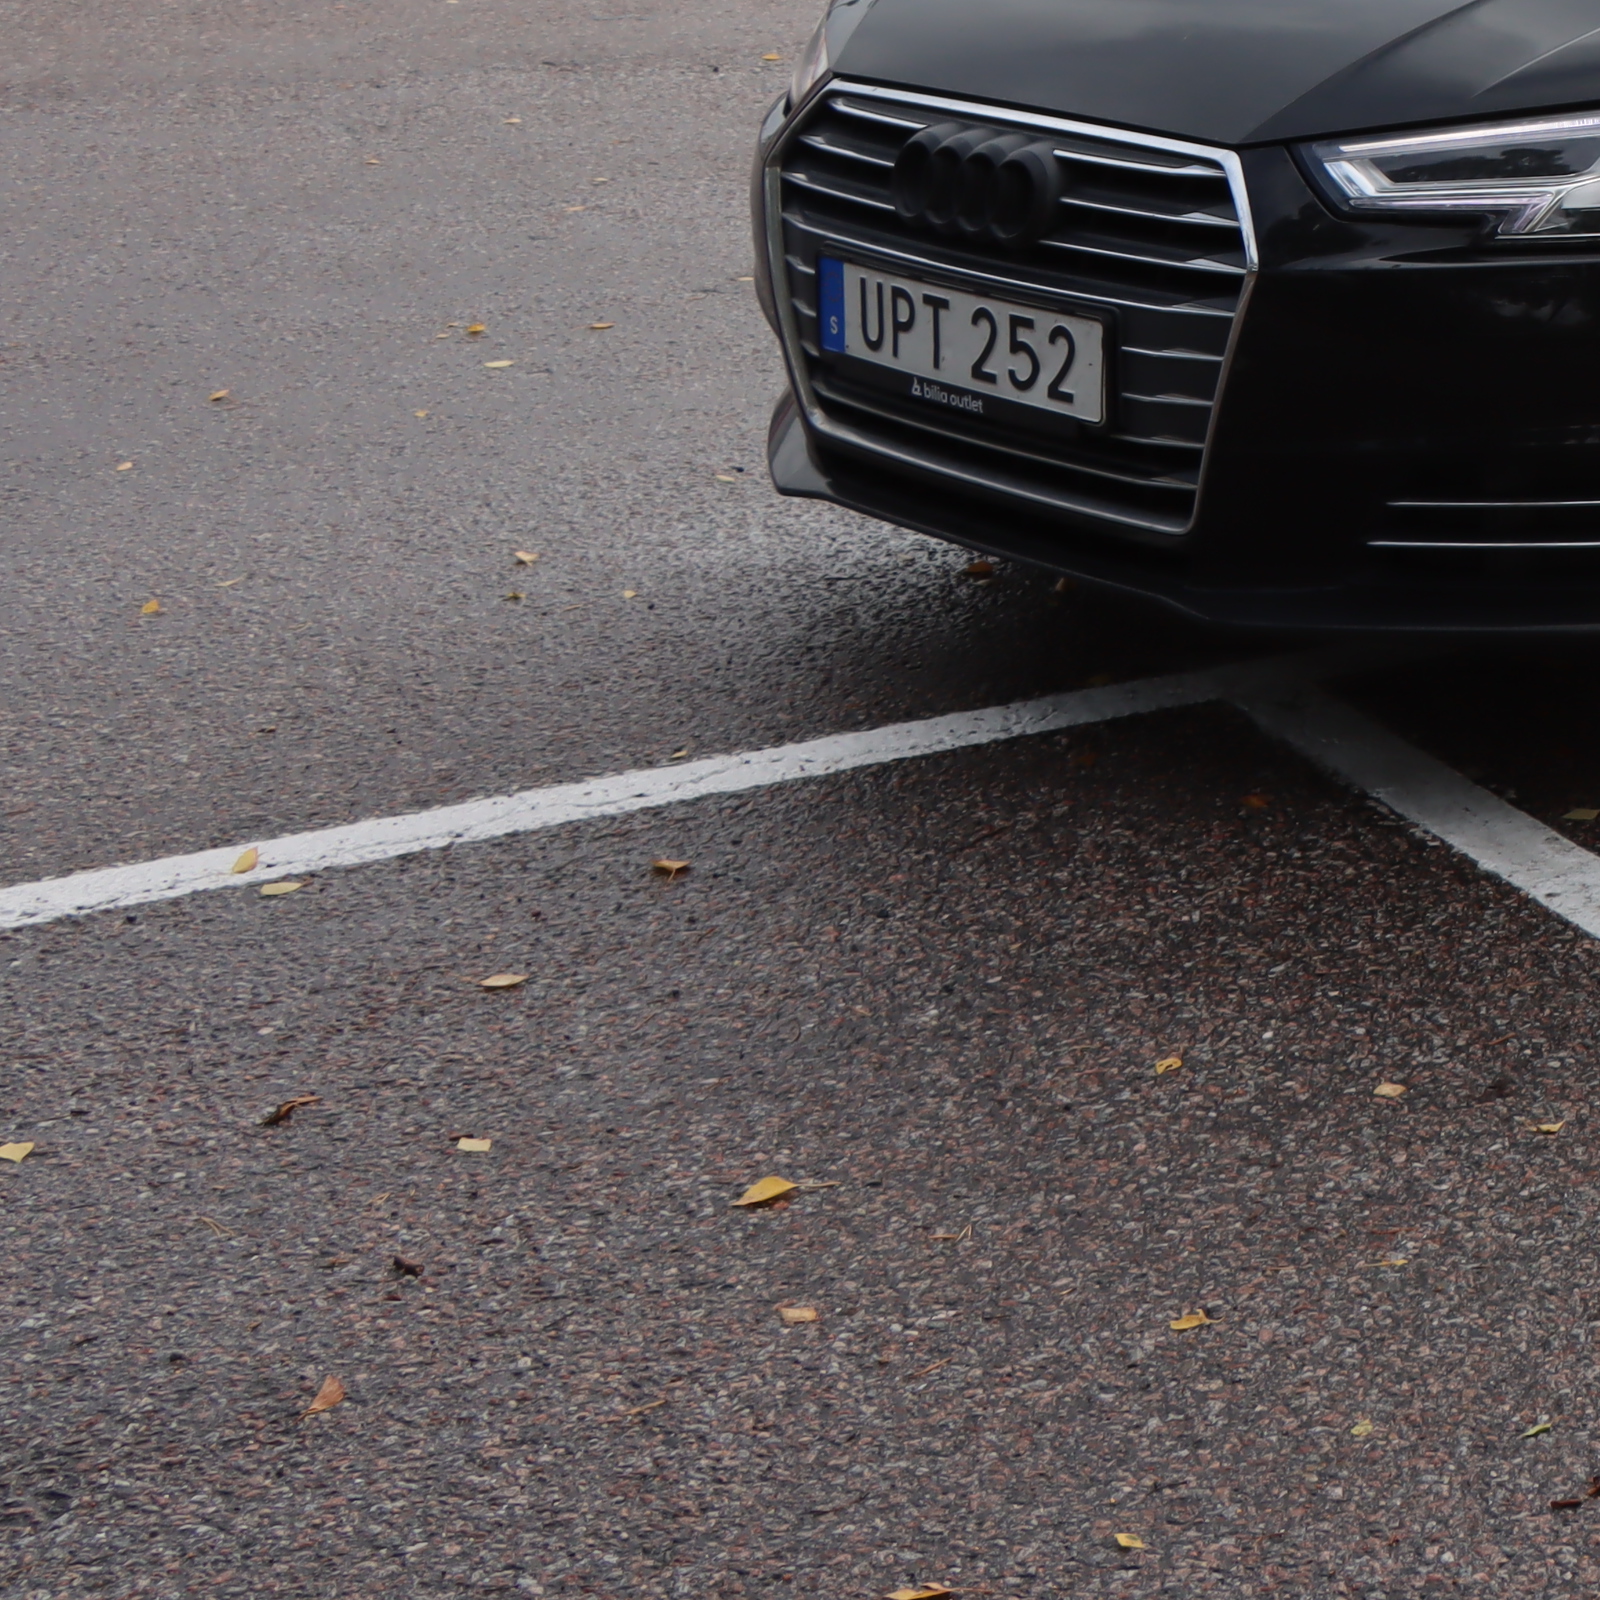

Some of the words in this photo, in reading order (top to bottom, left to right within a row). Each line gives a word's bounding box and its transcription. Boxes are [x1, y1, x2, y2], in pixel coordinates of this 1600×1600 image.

[829, 315, 840, 336] S
[859, 276, 950, 370] UPT
[970, 305, 1077, 404] 252
[923, 383, 949, 404] bilia
[949, 390, 984, 414] outlet
